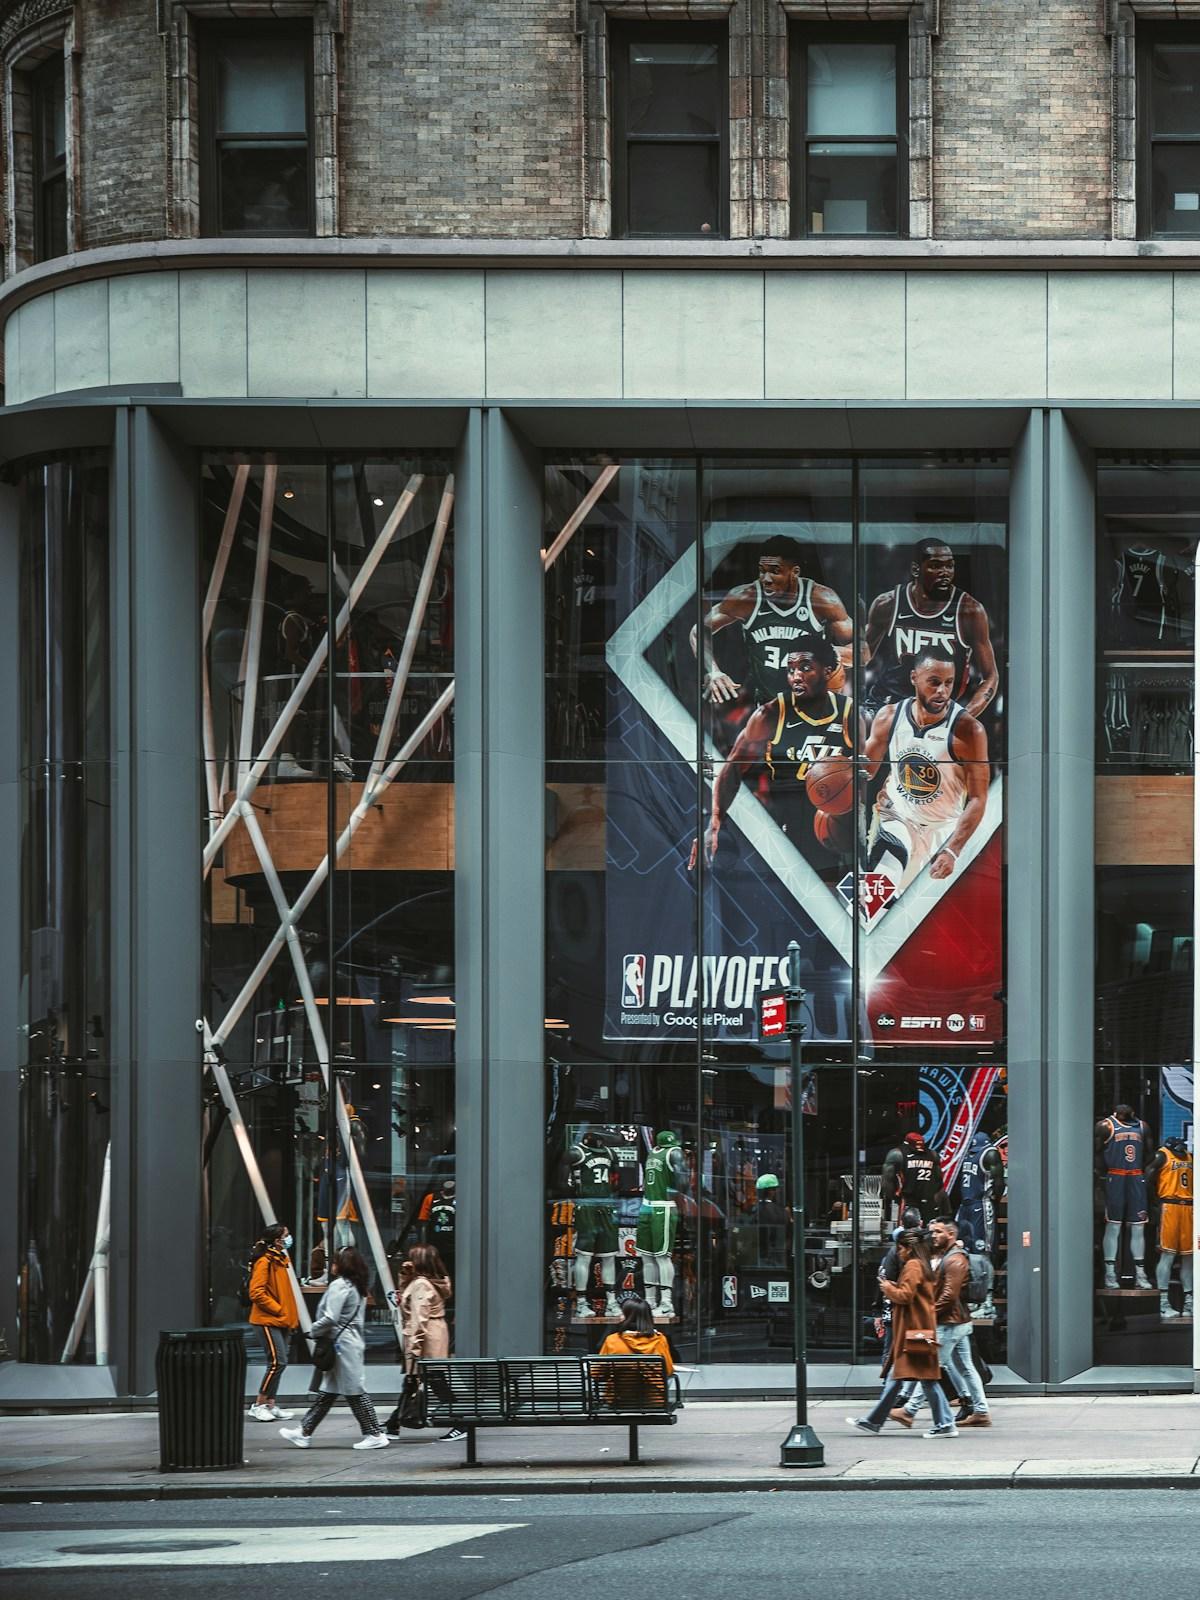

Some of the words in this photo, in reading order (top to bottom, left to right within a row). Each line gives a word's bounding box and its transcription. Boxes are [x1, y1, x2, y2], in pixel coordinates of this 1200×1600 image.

[1133, 575, 1143, 597] 7
[576, 586, 596, 606] 14
[795, 736, 845, 762] JAZZ
[918, 765, 934, 779] 30
[896, 784, 943, 805] WARRIORS
[621, 1012, 652, 1025] Presented
[714, 1013, 743, 1026] Pixel
[877, 1018, 896, 1026] abc
[900, 1016, 942, 1029] ESPN
[948, 1019, 964, 1028] TNT
[1124, 1144, 1136, 1163] 9
[907, 1160, 934, 1168] MIAMI
[592, 1168, 609, 1184] 34
[917, 1169, 932, 1181] 22
[622, 1272, 635, 1290] 4
